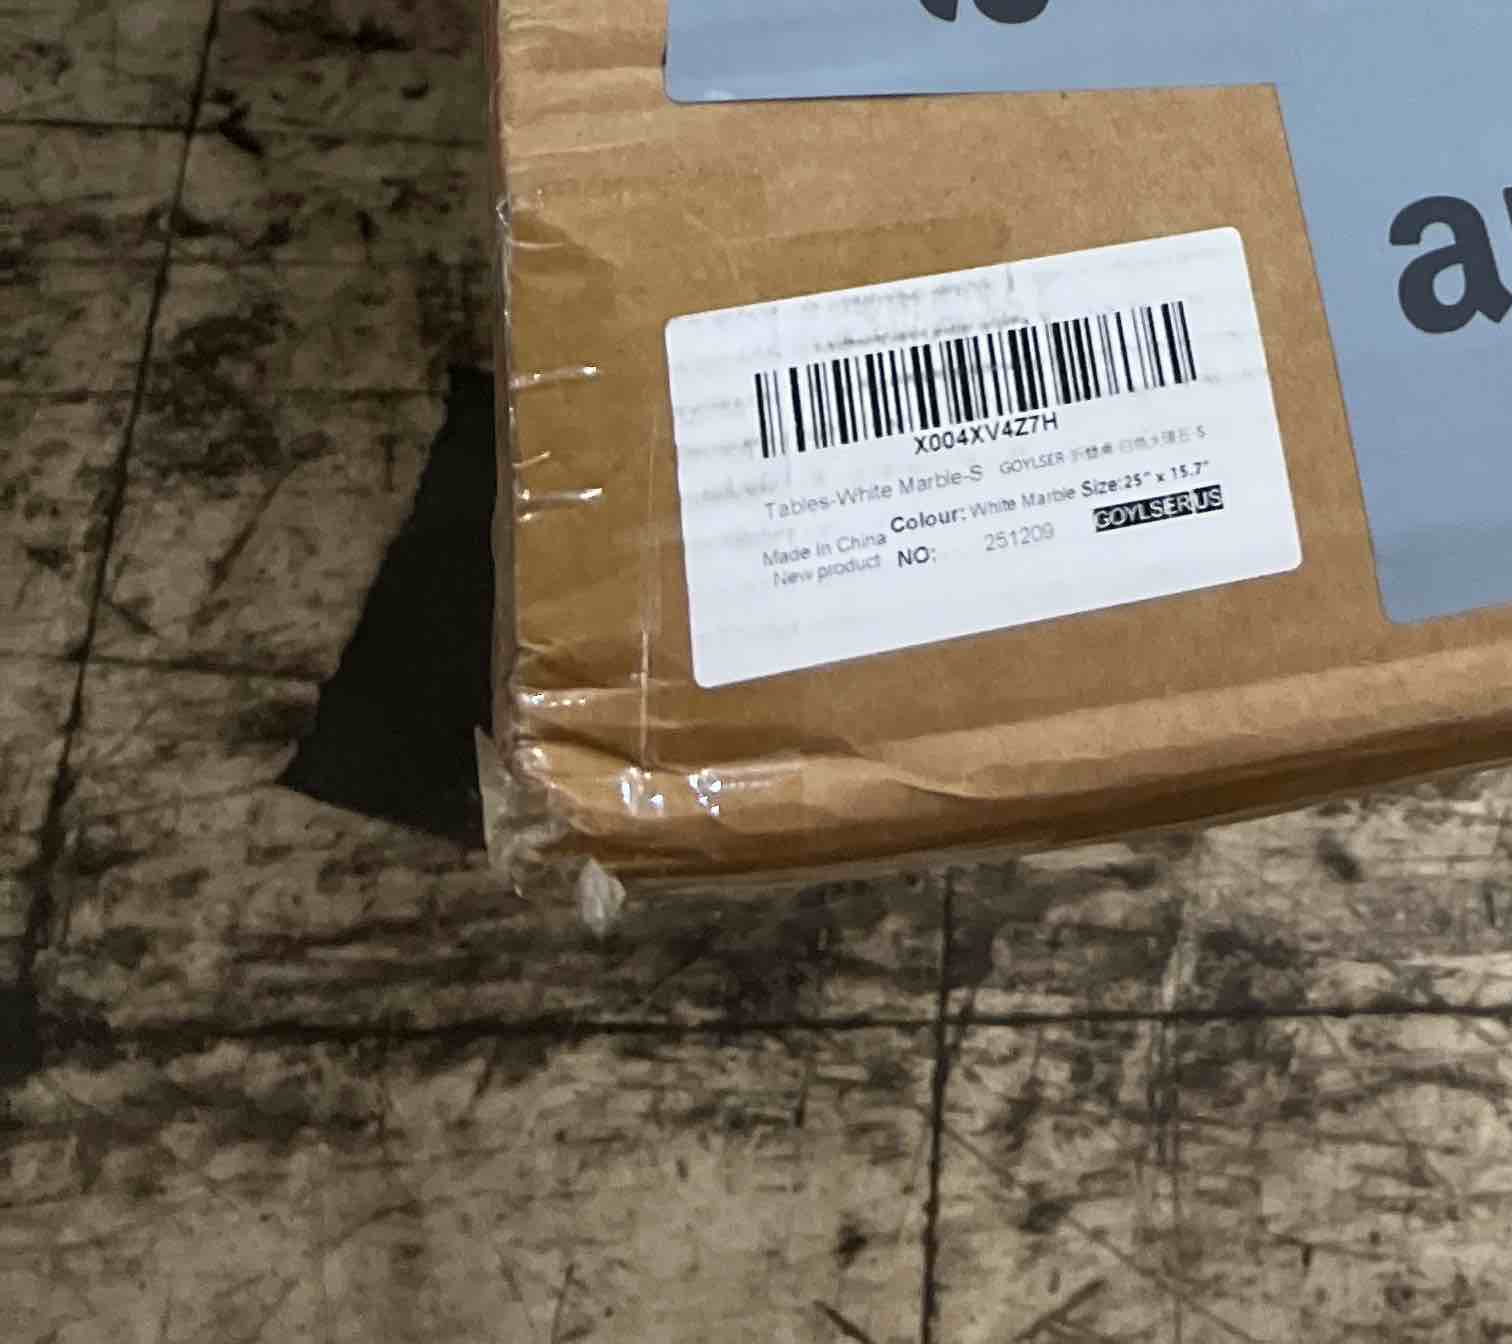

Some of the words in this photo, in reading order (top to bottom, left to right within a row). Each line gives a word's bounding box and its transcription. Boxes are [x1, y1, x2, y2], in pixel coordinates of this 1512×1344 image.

[913, 411, 1059, 456] X004XV4Z7H
[898, 463, 984, 496] Marble-S
[889, 506, 967, 534] Colour:
[969, 497, 1017, 520] White
[1020, 487, 1076, 509] Marble
[1094, 494, 1193, 531] GOYLSER
[762, 546, 811, 569] Made
[836, 531, 888, 555] China
[816, 553, 882, 583] product
